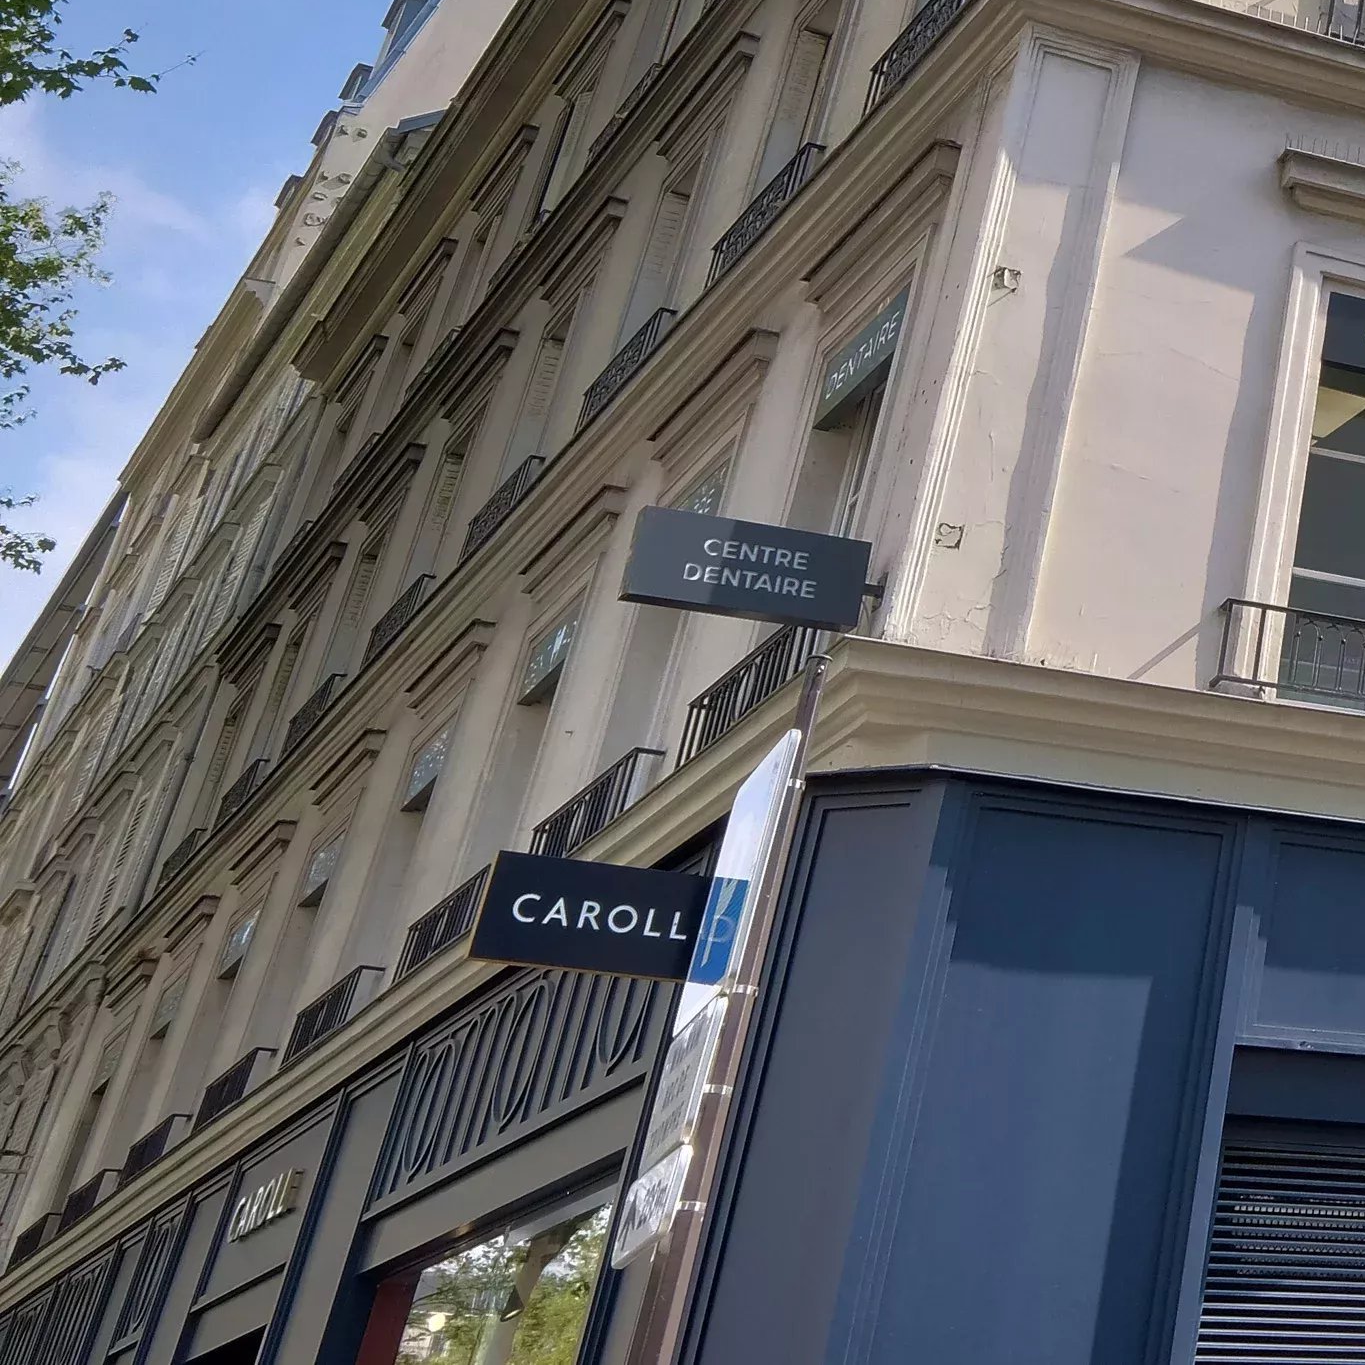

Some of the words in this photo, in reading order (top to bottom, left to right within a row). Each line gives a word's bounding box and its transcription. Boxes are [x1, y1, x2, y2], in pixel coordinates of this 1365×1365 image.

[825, 310, 900, 400] DENTAIRE
[703, 538, 810, 571] CENTRE
[682, 562, 817, 599] DENTAIRE
[512, 893, 687, 940] CAROLL
[227, 1167, 295, 1243] CAROLL
